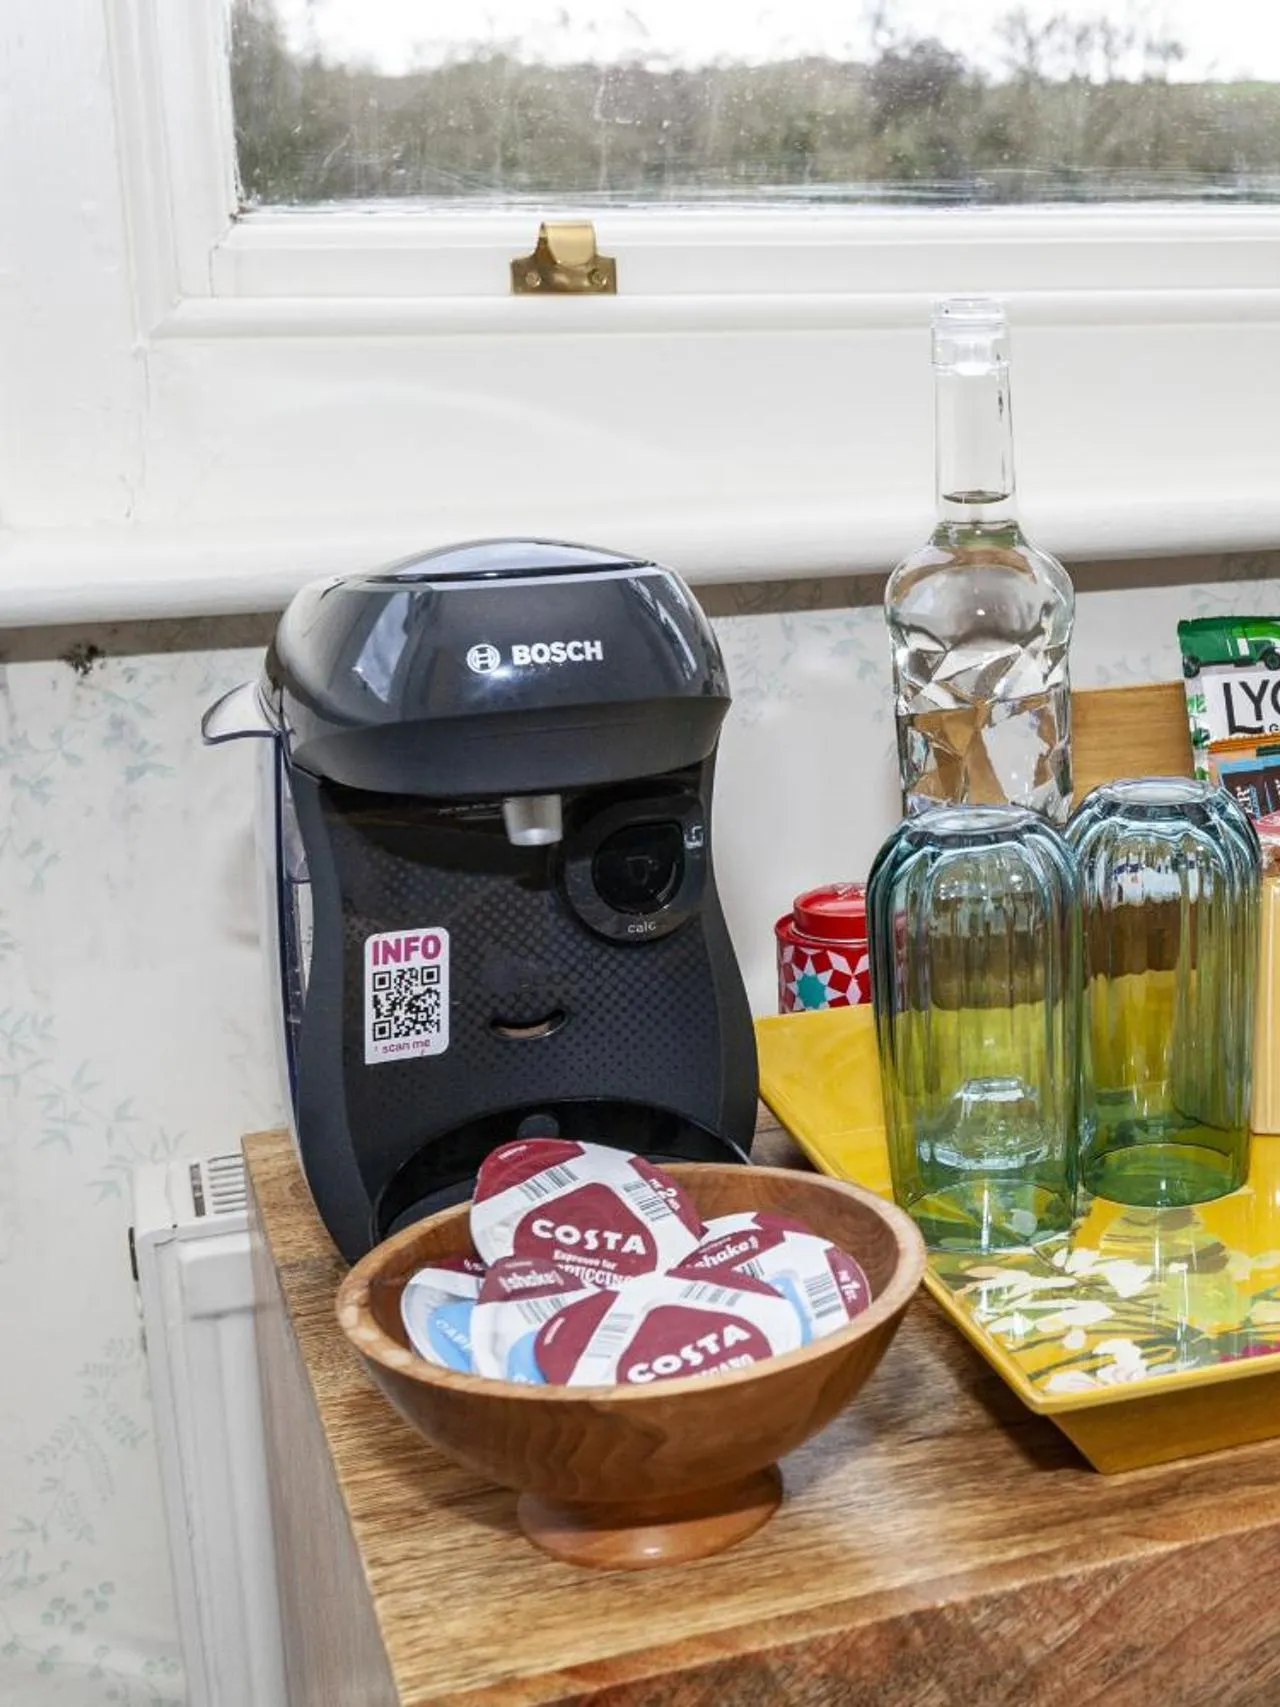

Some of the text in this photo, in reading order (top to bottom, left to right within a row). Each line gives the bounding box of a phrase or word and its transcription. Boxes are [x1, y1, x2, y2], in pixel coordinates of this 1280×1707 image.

[511, 640, 604, 666] BOSCH
[627, 921, 657, 933] calc
[372, 934, 442, 966] INFO
[382, 1039, 431, 1054] scan me
[531, 1219, 646, 1255] COSTA
[627, 1324, 751, 1383] COSTA
